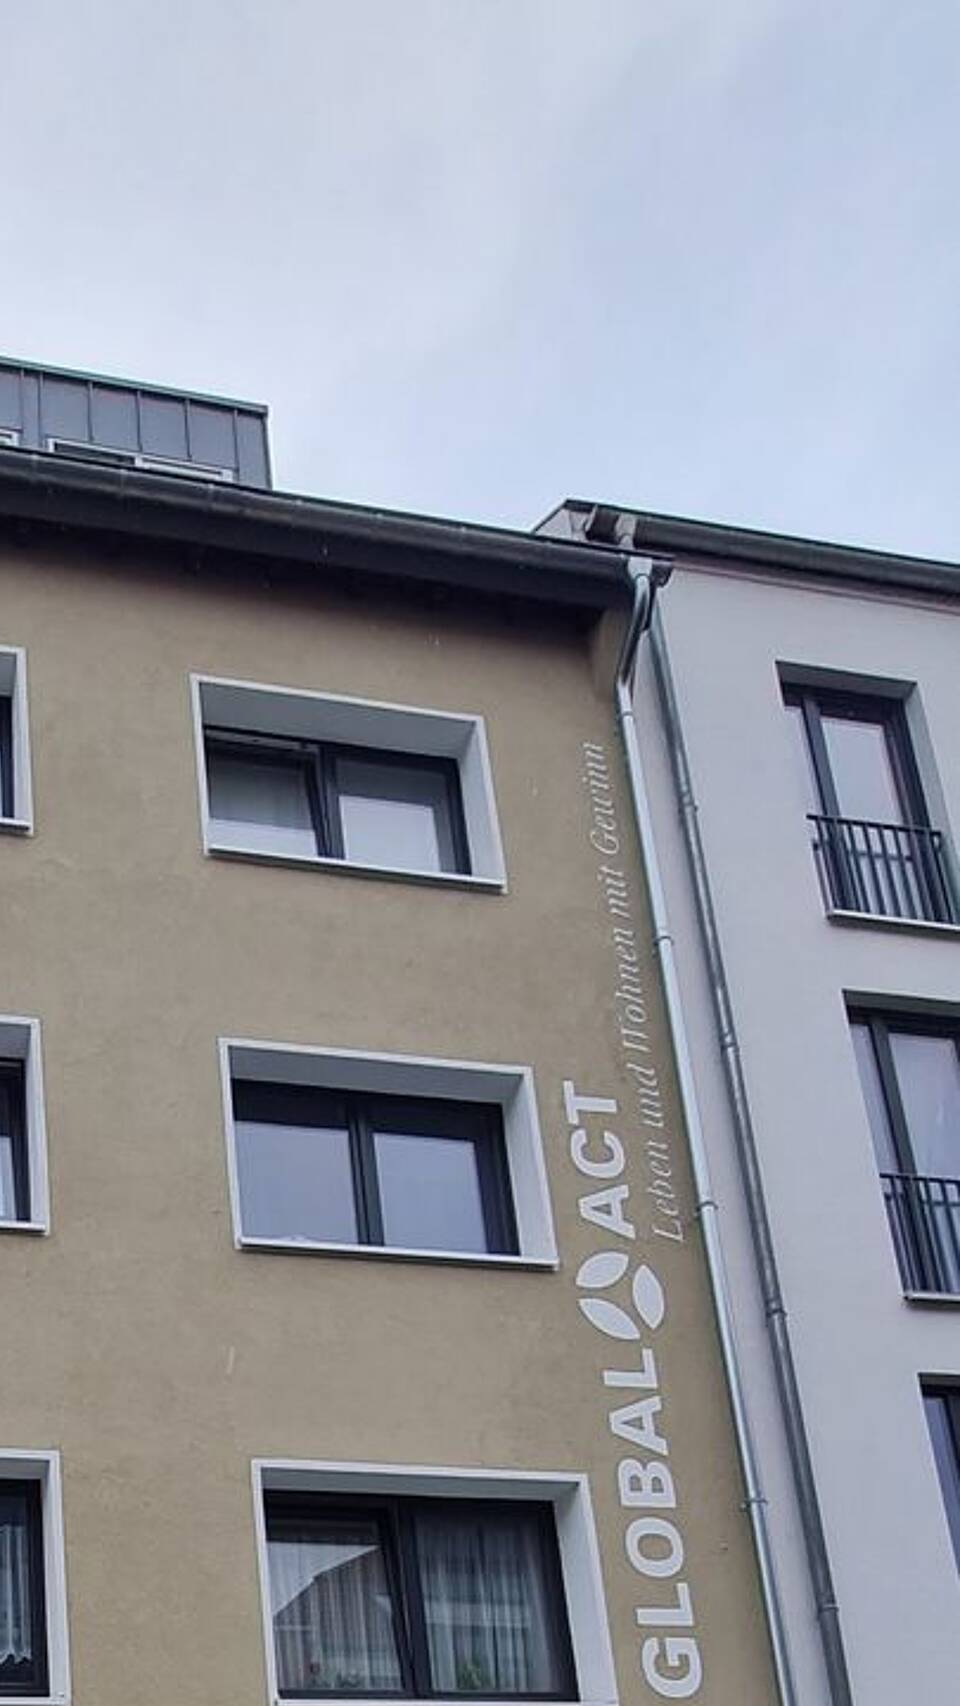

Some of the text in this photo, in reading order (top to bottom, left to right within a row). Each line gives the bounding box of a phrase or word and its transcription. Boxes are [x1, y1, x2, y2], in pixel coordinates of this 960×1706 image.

[582, 741, 685, 1243] Leben und Wohnen mit Gewinn
[563, 1080, 702, 1698] GLOBAL ACT
